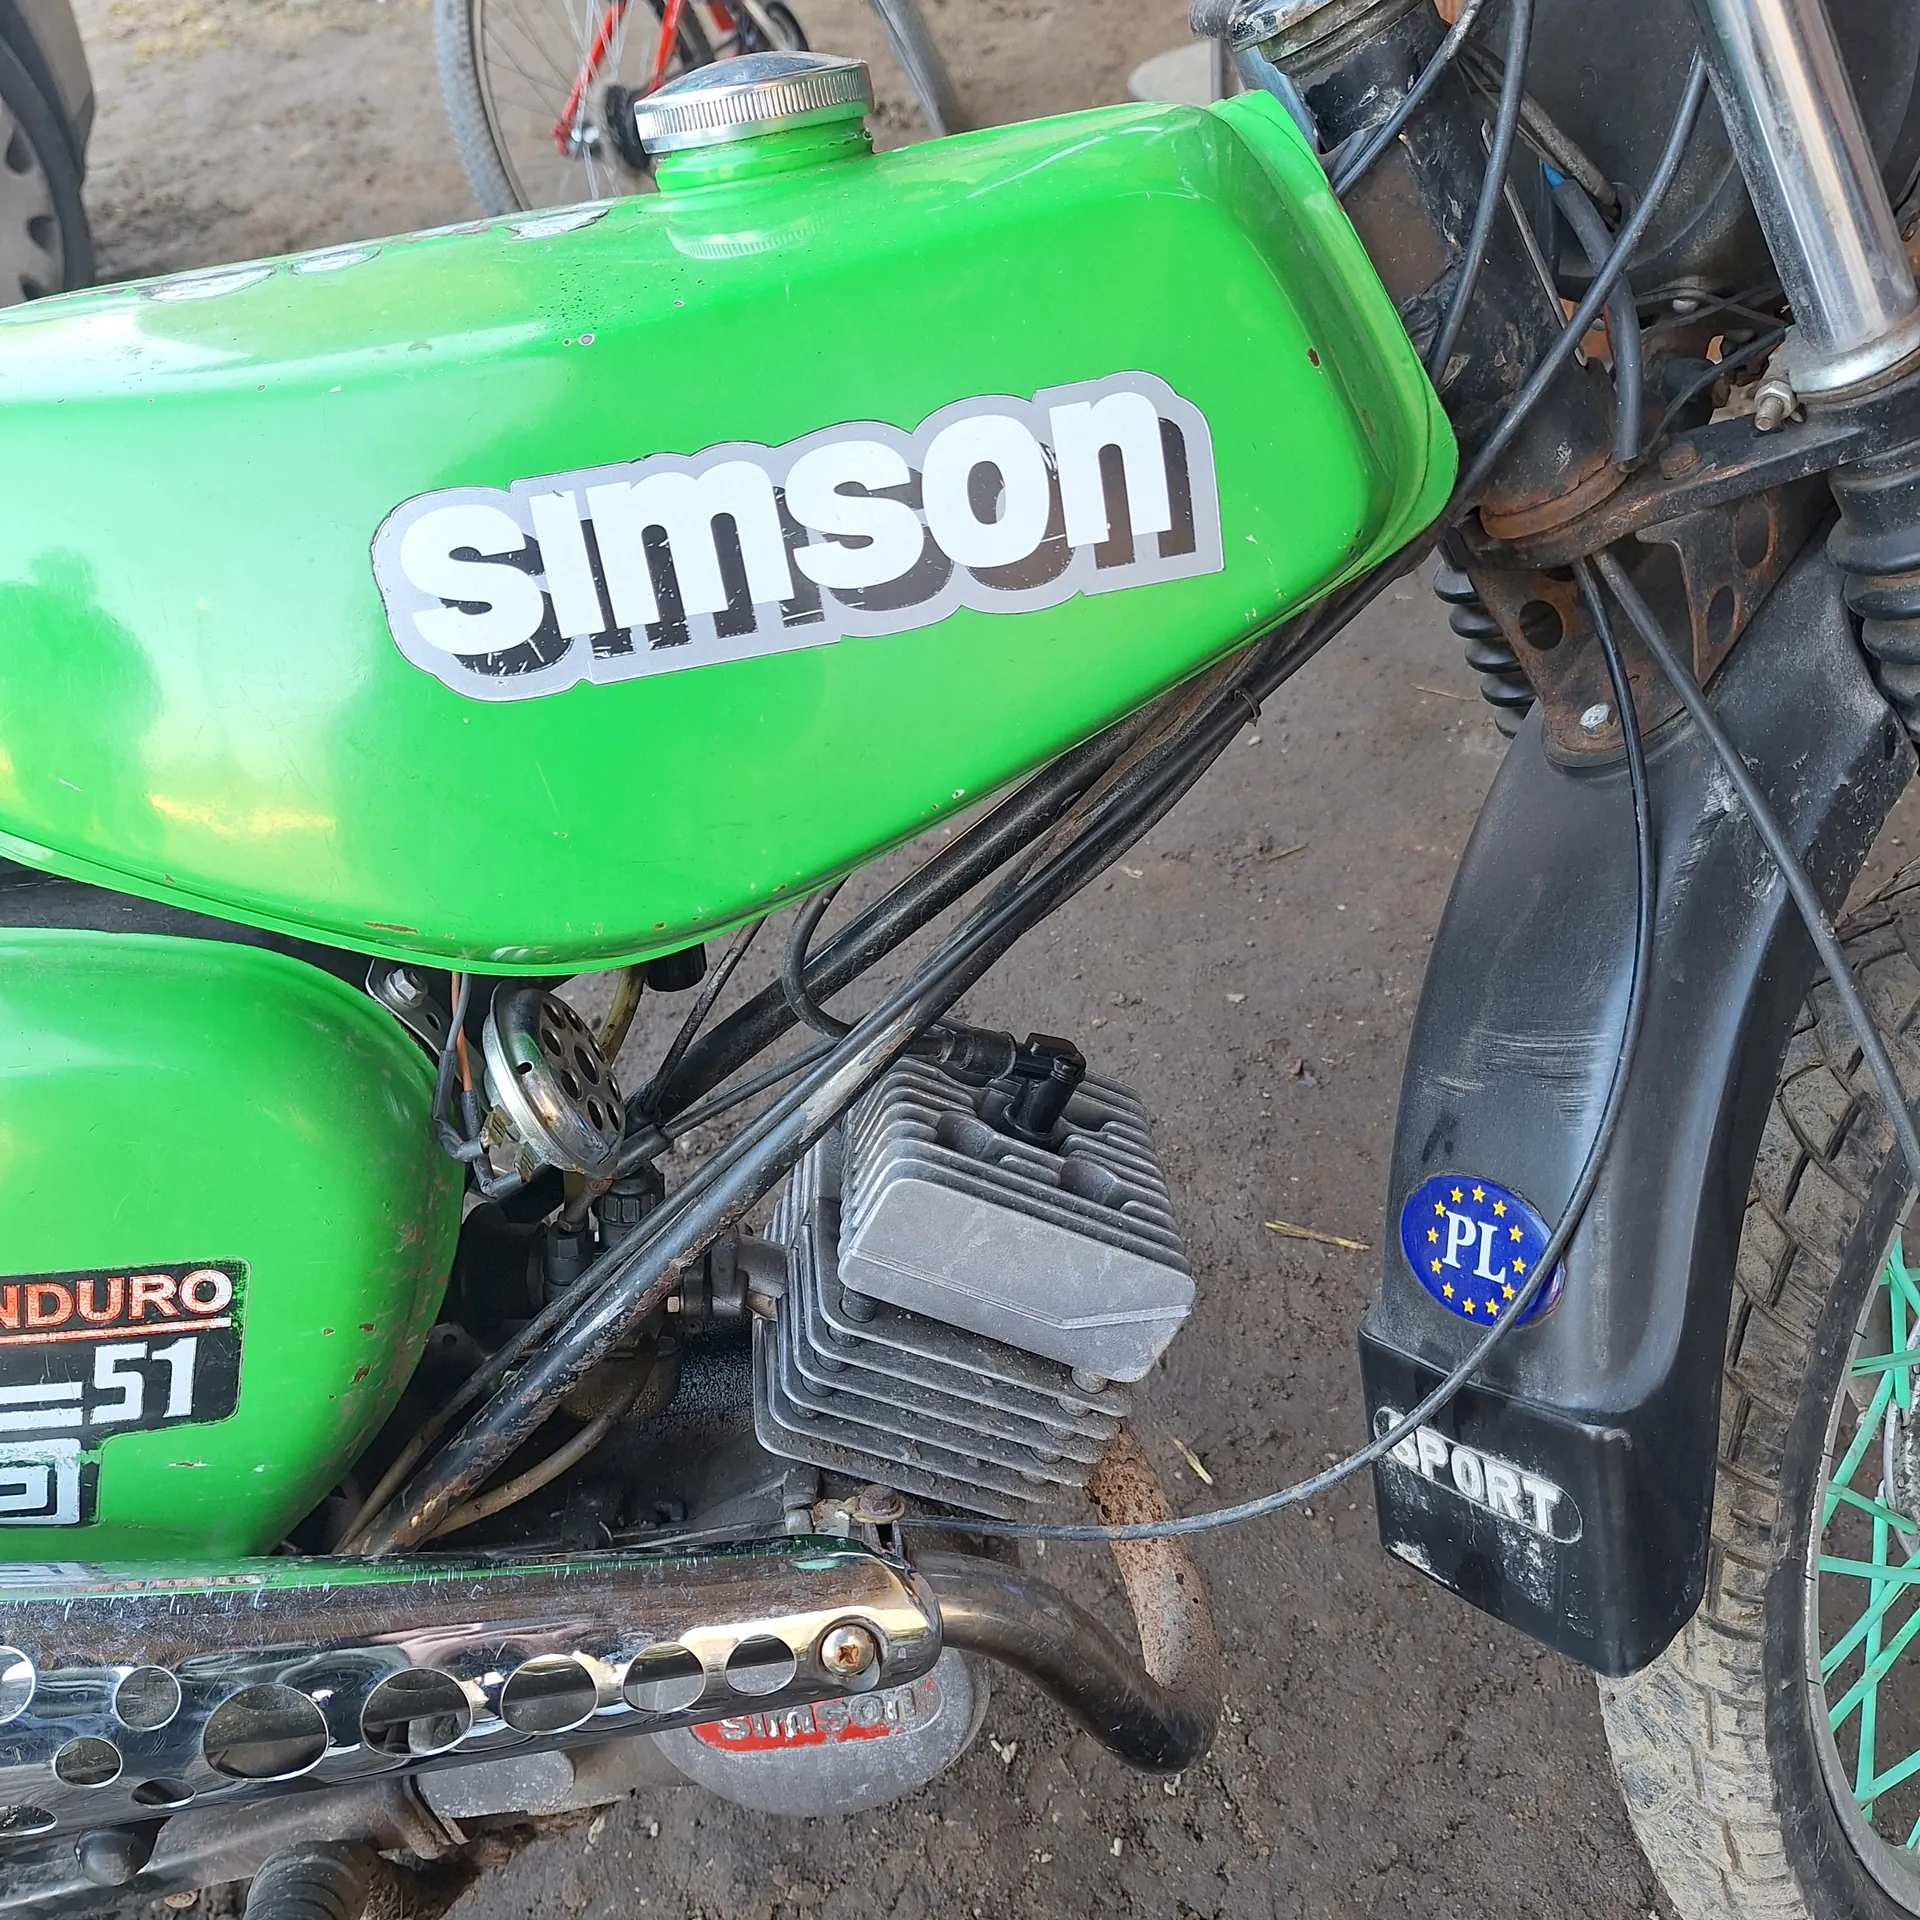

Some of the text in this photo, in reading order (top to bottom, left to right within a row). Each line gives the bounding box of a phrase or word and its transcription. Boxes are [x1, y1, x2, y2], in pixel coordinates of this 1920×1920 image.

[398, 391, 1198, 677] simson
[1442, 1211, 1506, 1285] PL
[90, 1337, 198, 1425] 51
[1388, 1413, 1560, 1533] SPORT
